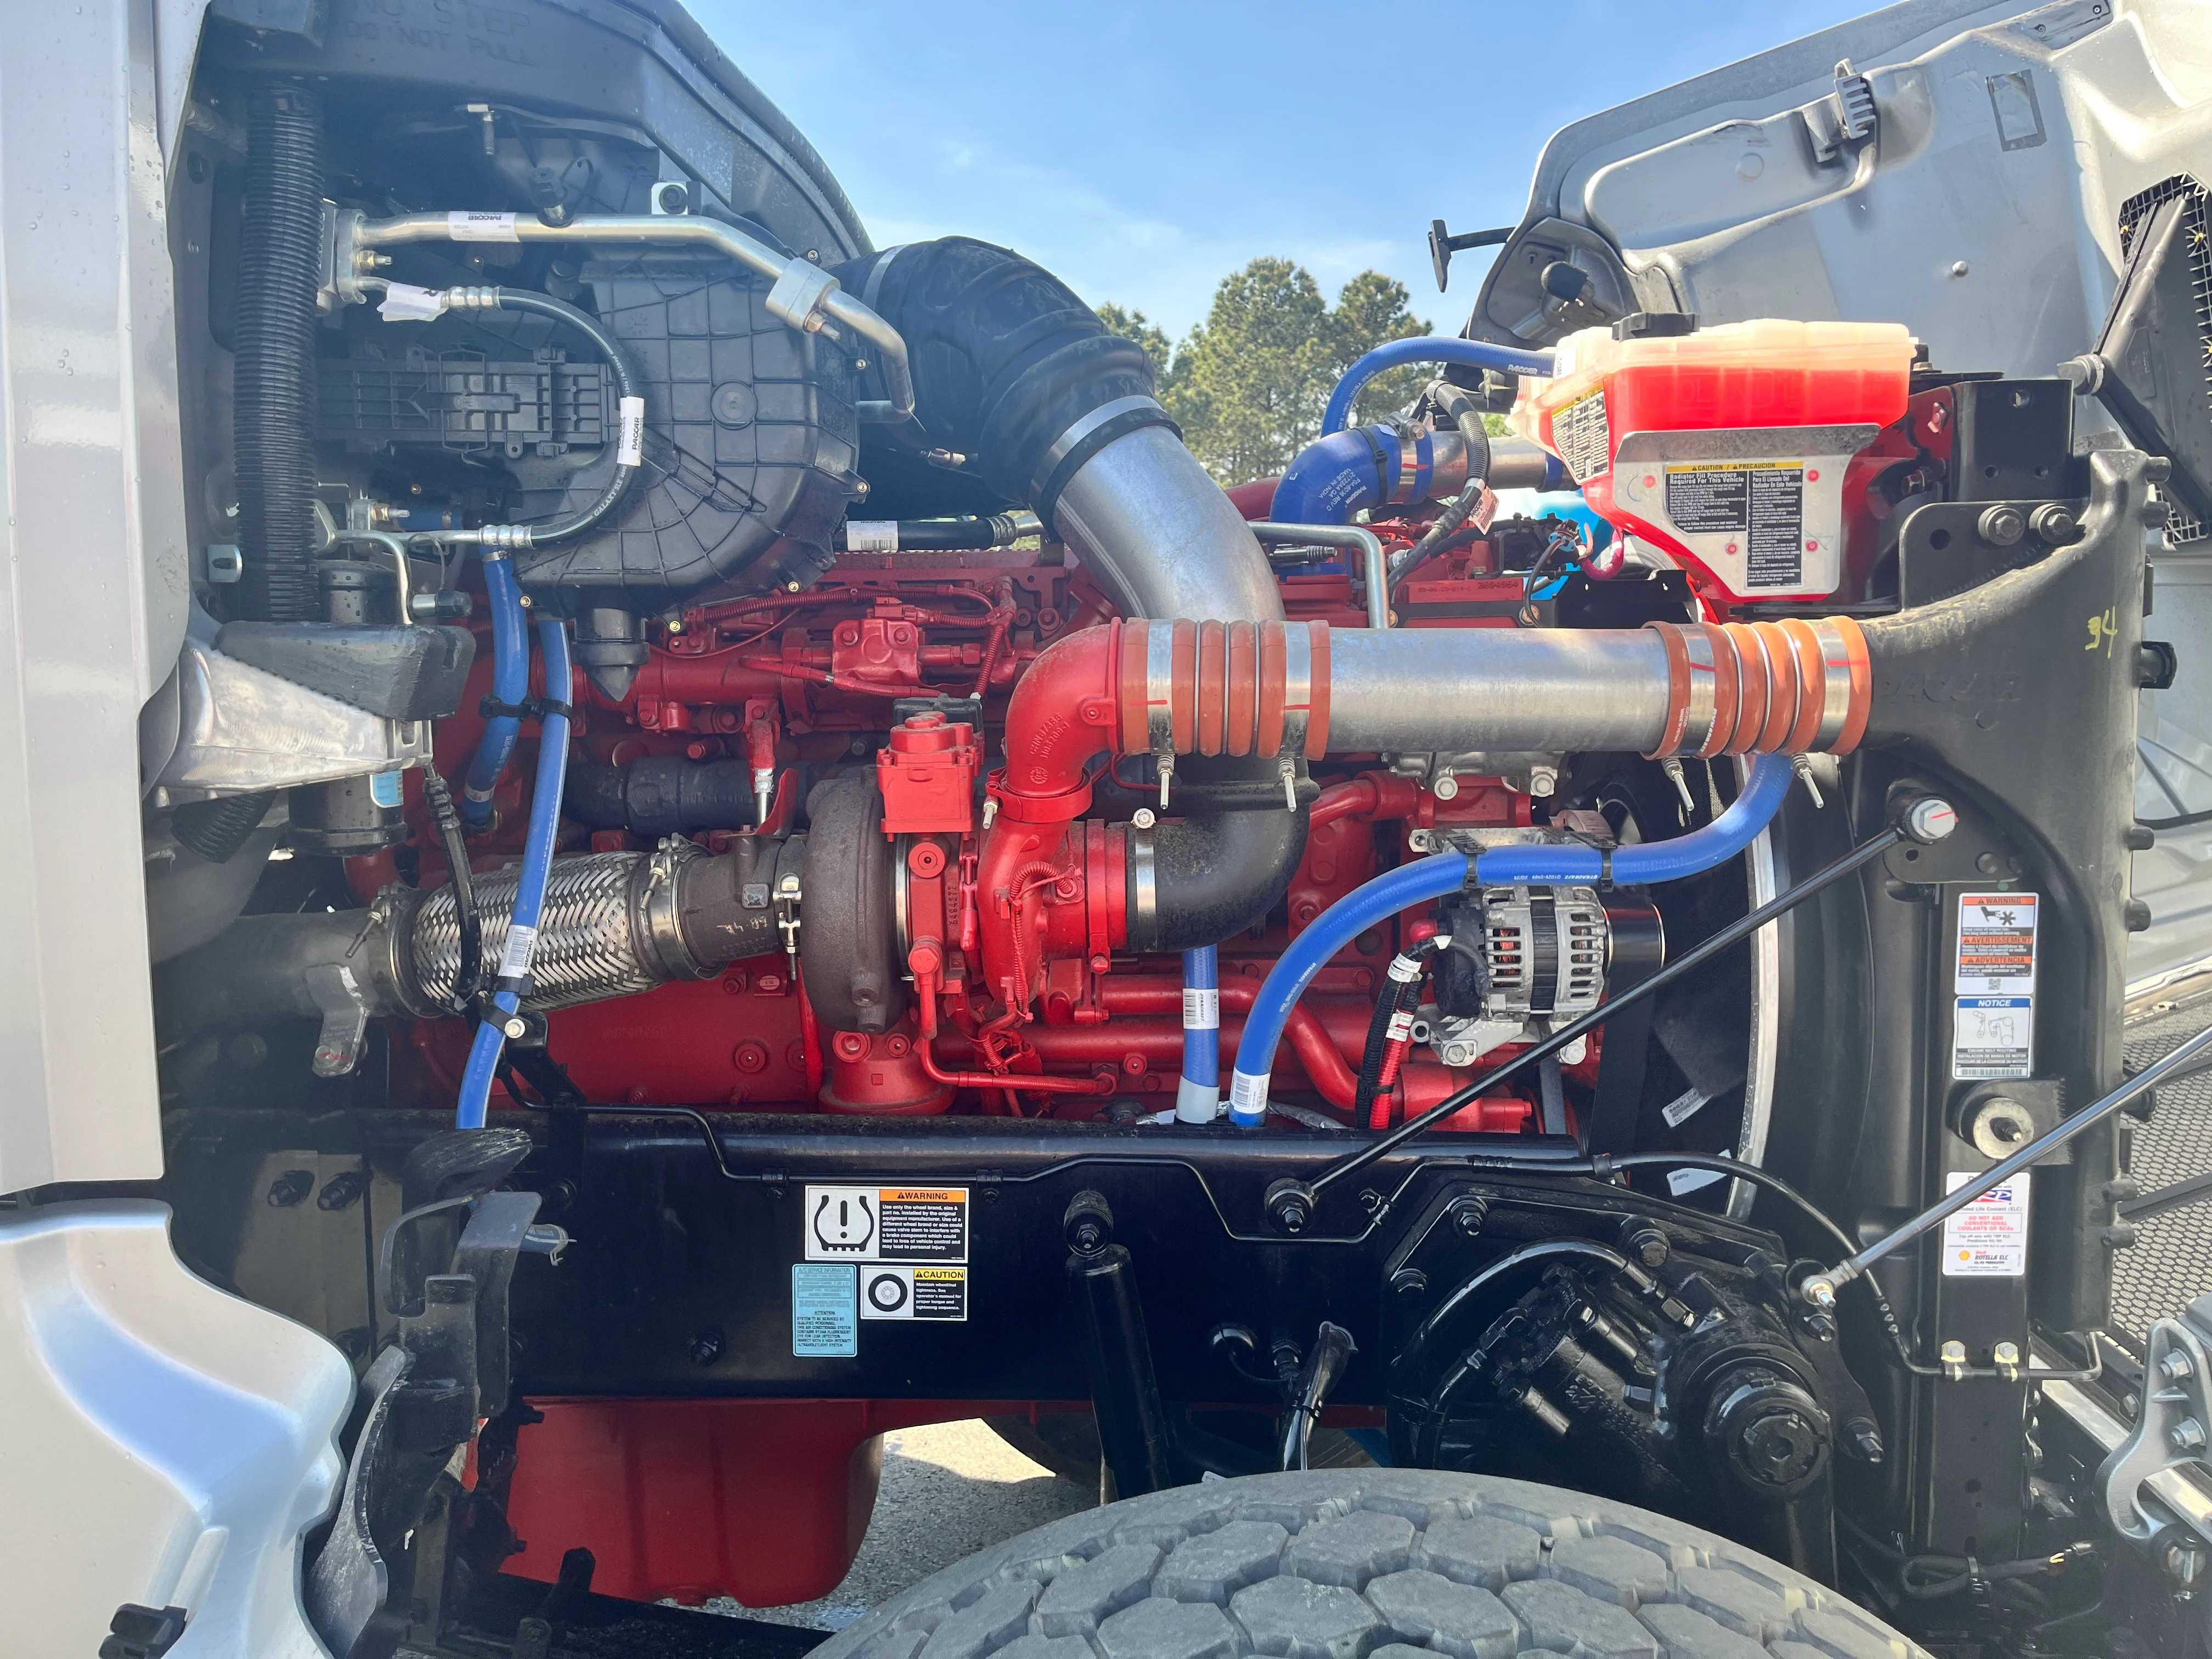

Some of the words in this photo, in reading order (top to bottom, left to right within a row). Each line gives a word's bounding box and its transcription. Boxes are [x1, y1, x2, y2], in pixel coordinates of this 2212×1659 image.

[1508, 364, 1537, 375] PACCAR
[631, 417, 640, 450] PACCAR
[1336, 468, 1351, 481] MADE
[1318, 485, 1332, 499] INDIA
[1345, 485, 1367, 504] PACCAR
[594, 489, 617, 517] GALAXY
[1330, 495, 1341, 507] REV
[1470, 499, 1483, 518] PACCAR
